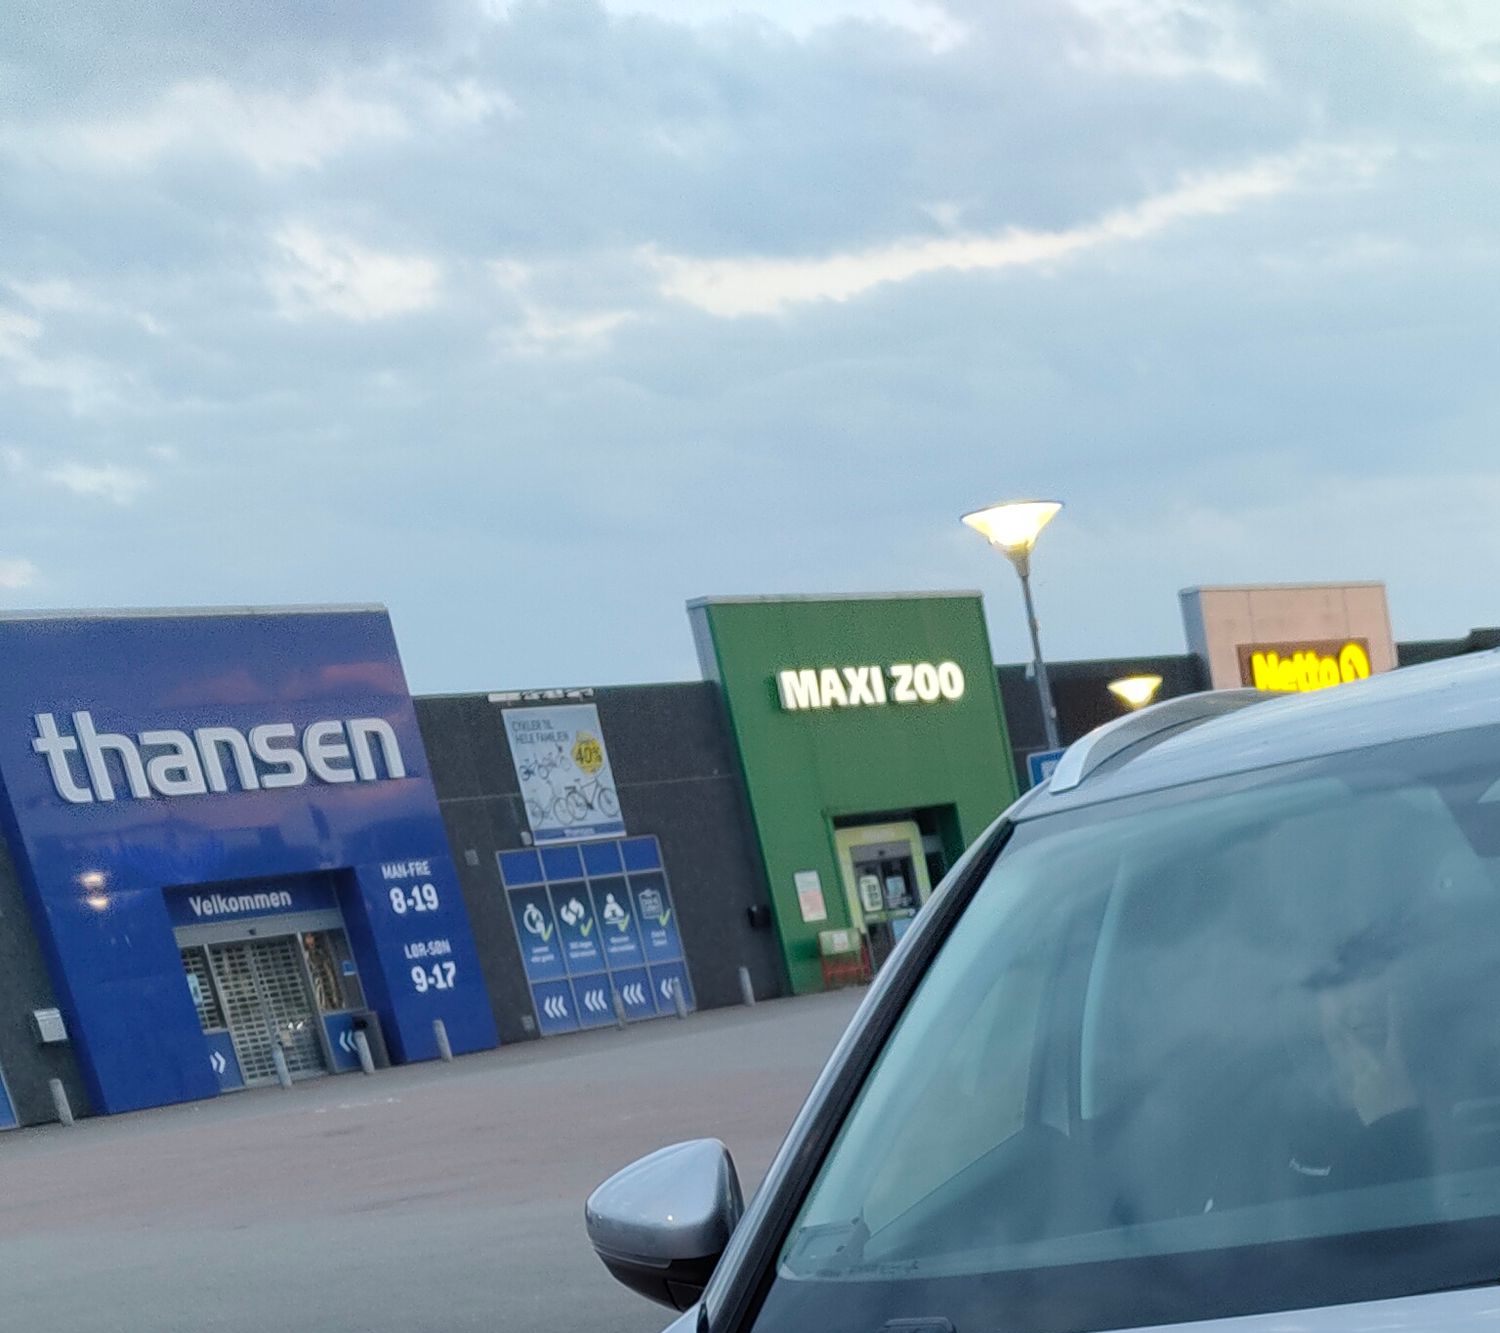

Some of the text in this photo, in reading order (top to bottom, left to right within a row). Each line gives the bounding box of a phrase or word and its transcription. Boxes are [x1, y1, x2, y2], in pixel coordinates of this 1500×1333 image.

[776, 660, 966, 710] MAXI ZOO
[1251, 650, 1341, 692] Netto
[32, 710, 406, 804] thansen
[381, 860, 432, 880] MAN-FRE
[189, 891, 292, 917] Velkommen
[389, 883, 439, 915] 8-19
[411, 961, 457, 993] 9-17
